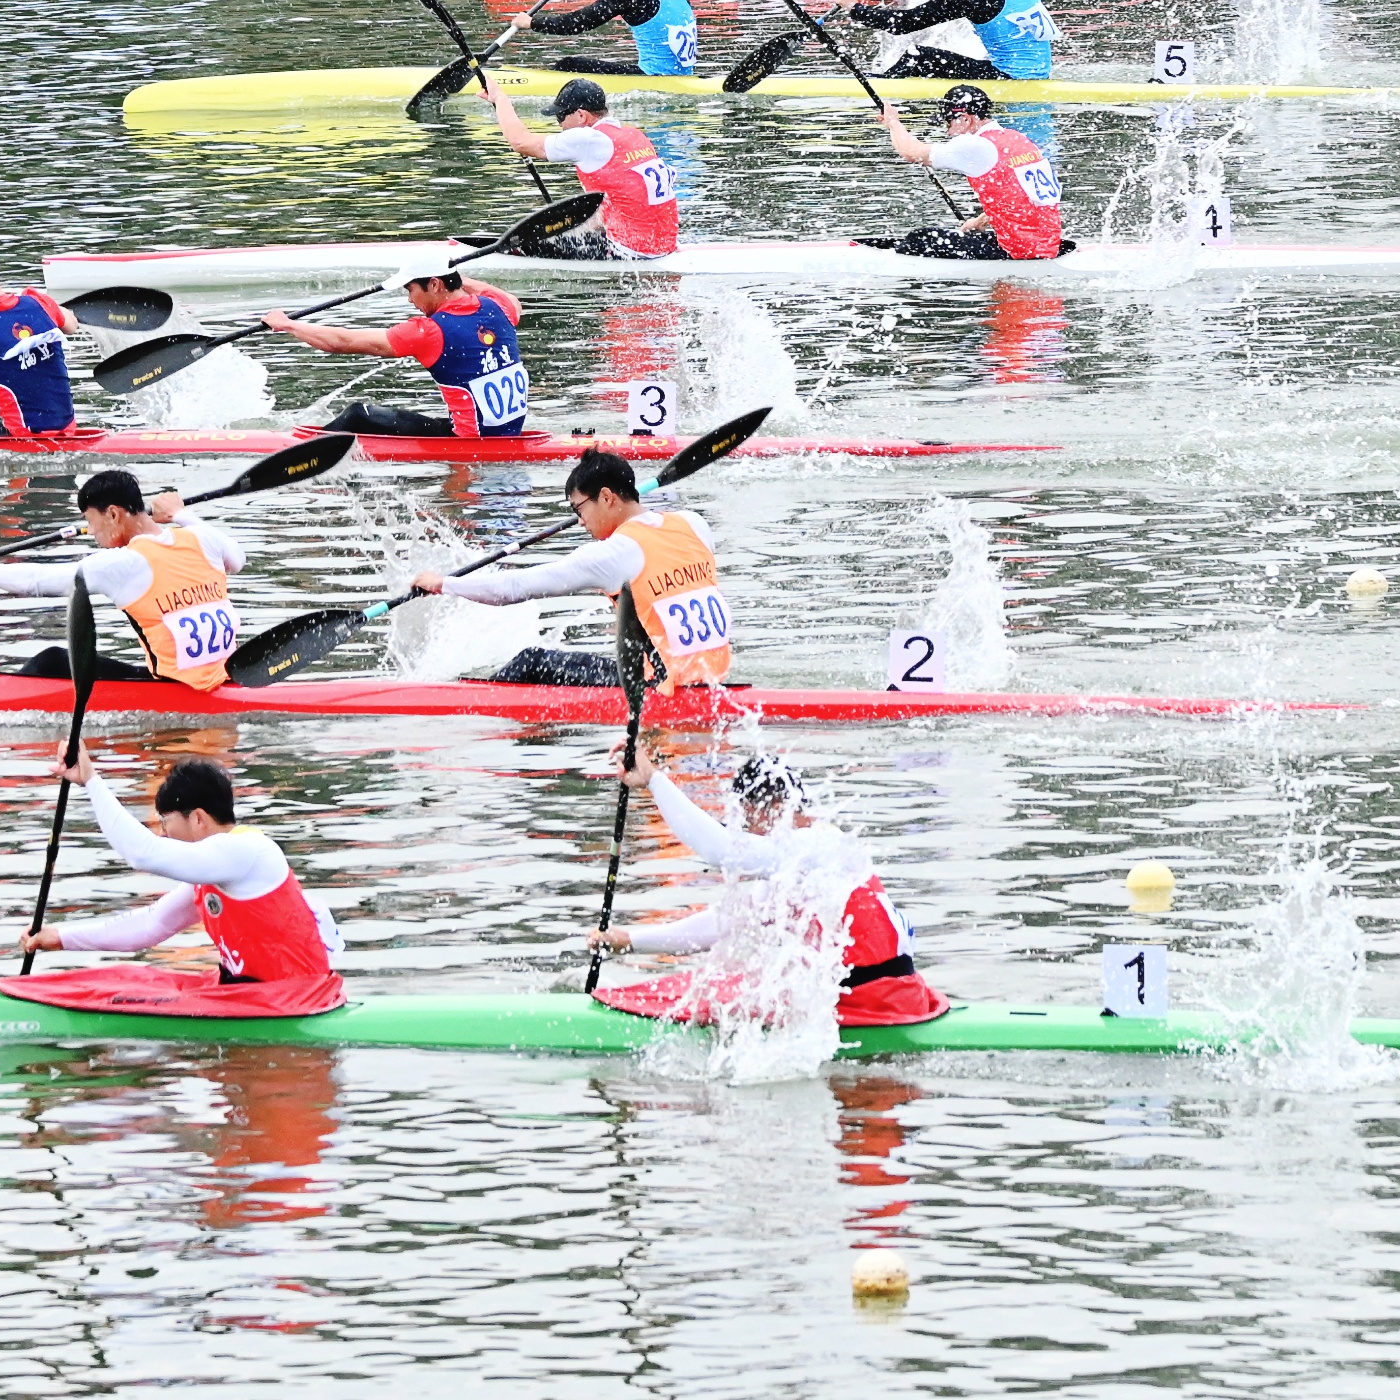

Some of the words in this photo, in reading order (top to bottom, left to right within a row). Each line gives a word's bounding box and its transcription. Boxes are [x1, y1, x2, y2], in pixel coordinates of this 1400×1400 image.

[1163, 45, 1188, 78] 5
[483, 370, 527, 419] 029
[640, 385, 667, 426] 3
[140, 433, 248, 441] SEAFLO
[560, 437, 669, 448] SEAFLO
[156, 581, 224, 615] LIAONING
[648, 561, 713, 597] LIAONING
[178, 608, 234, 658] 328
[669, 595, 726, 646] 330
[901, 635, 935, 682] 2
[1123, 951, 1145, 1005] 1
